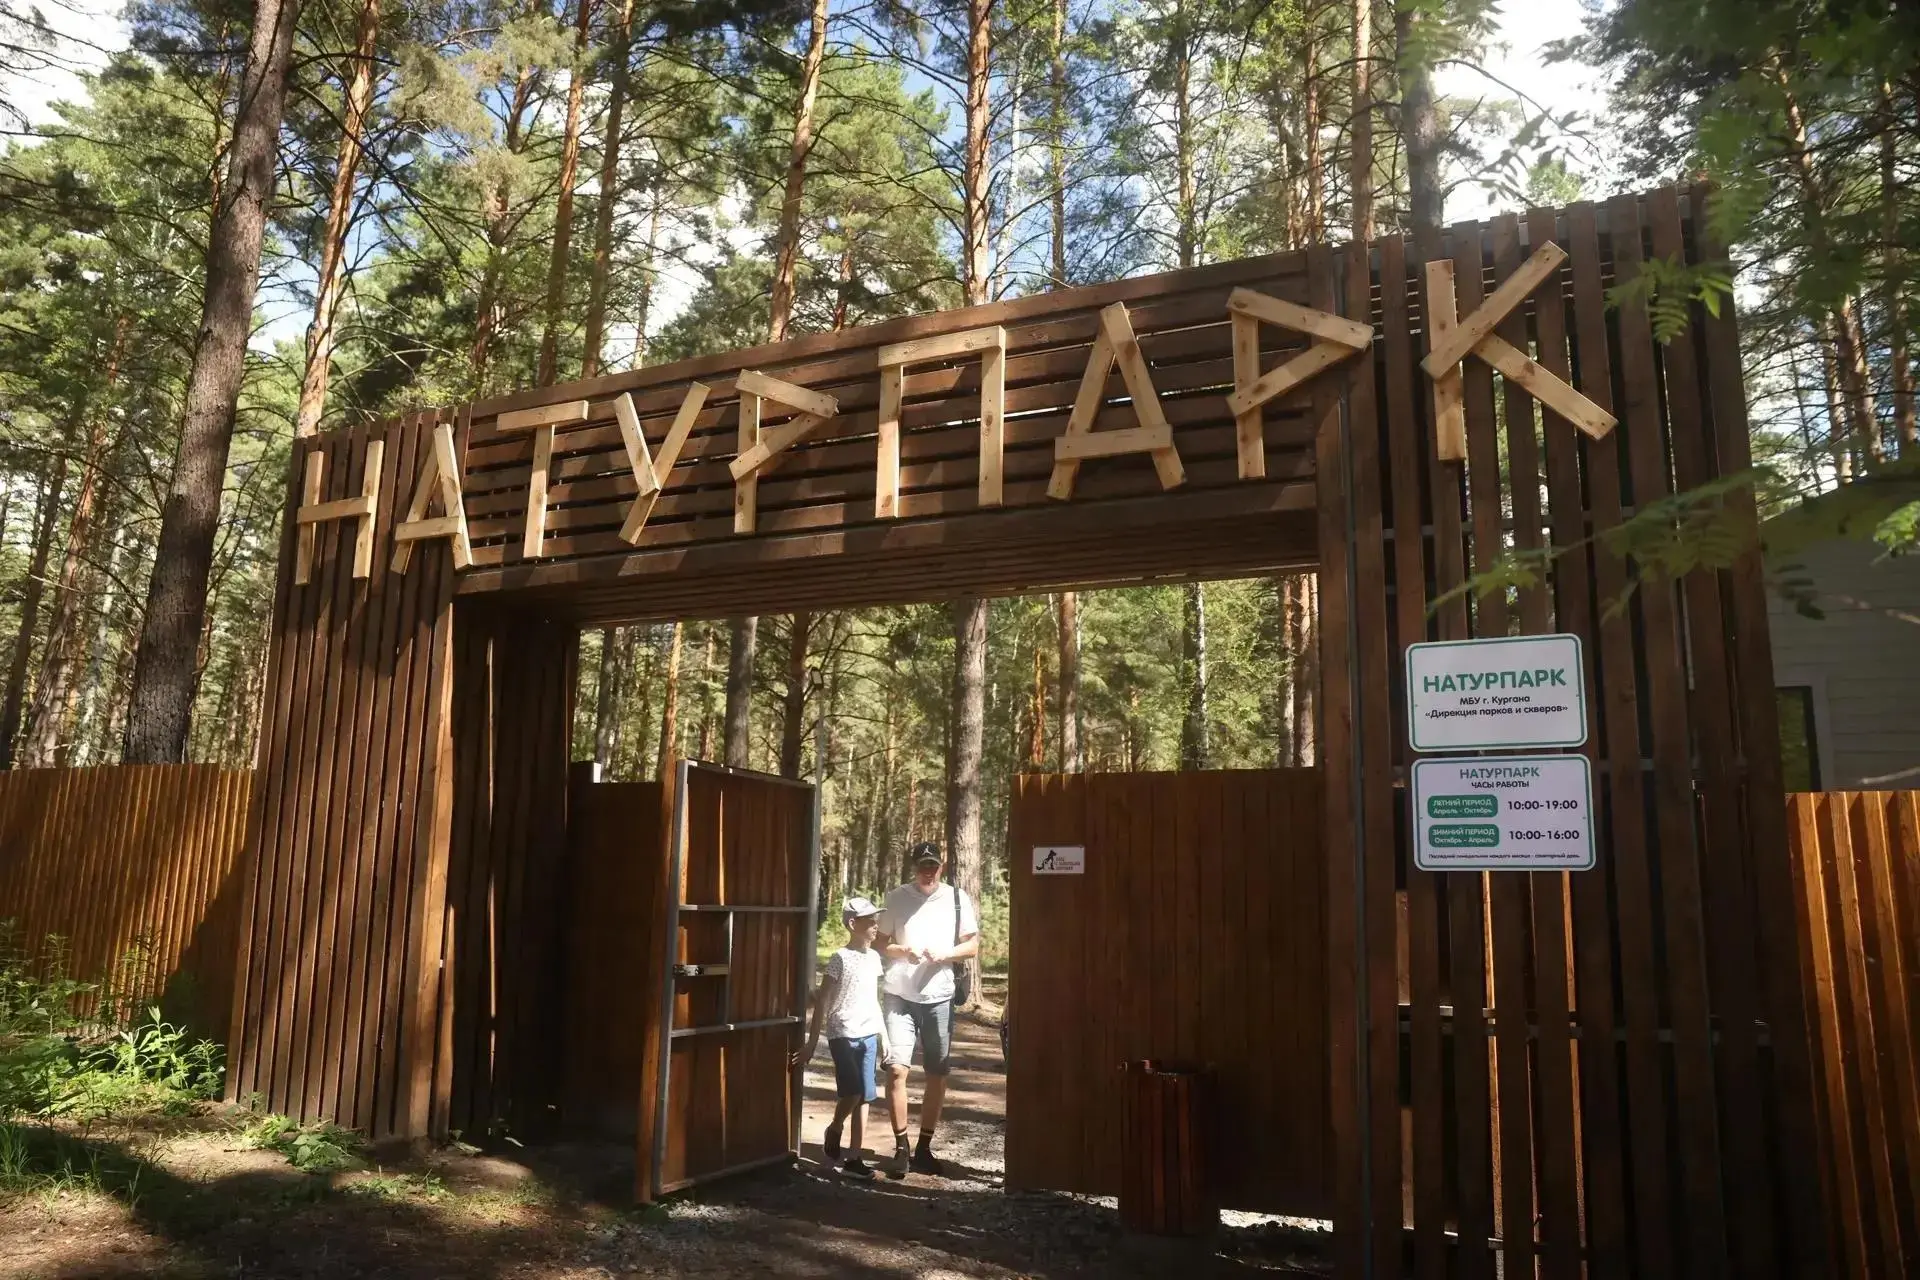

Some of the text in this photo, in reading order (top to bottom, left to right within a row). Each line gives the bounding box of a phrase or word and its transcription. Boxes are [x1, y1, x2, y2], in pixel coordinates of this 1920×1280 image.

[296, 240, 1619, 586] НАТУРПАРК
[1423, 668, 1567, 693] НАТУРПАРК
[1459, 695, 1531, 706] МБУ г. Кургана
[1425, 704, 1569, 719] «Дирекция парков и скверов»
[1460, 767, 1540, 780] НАТУРПАРК
[1471, 780, 1530, 789] ЧАСЫ РАБОТЫ
[1433, 798, 1493, 807] ЛЕТНИЙ ПЕРИОД
[1508, 799, 1579, 811] 10:00-19:00
[1433, 807, 1459, 816] Апрель
[1463, 806, 1494, 815] Октябрь
[1432, 827, 1496, 836] ЗИМНИЙ ПЕРИОД
[1509, 829, 1580, 841] 10:00-16:00
[1434, 837, 1463, 846] Октябрь
[1467, 836, 1495, 845] Апрель
